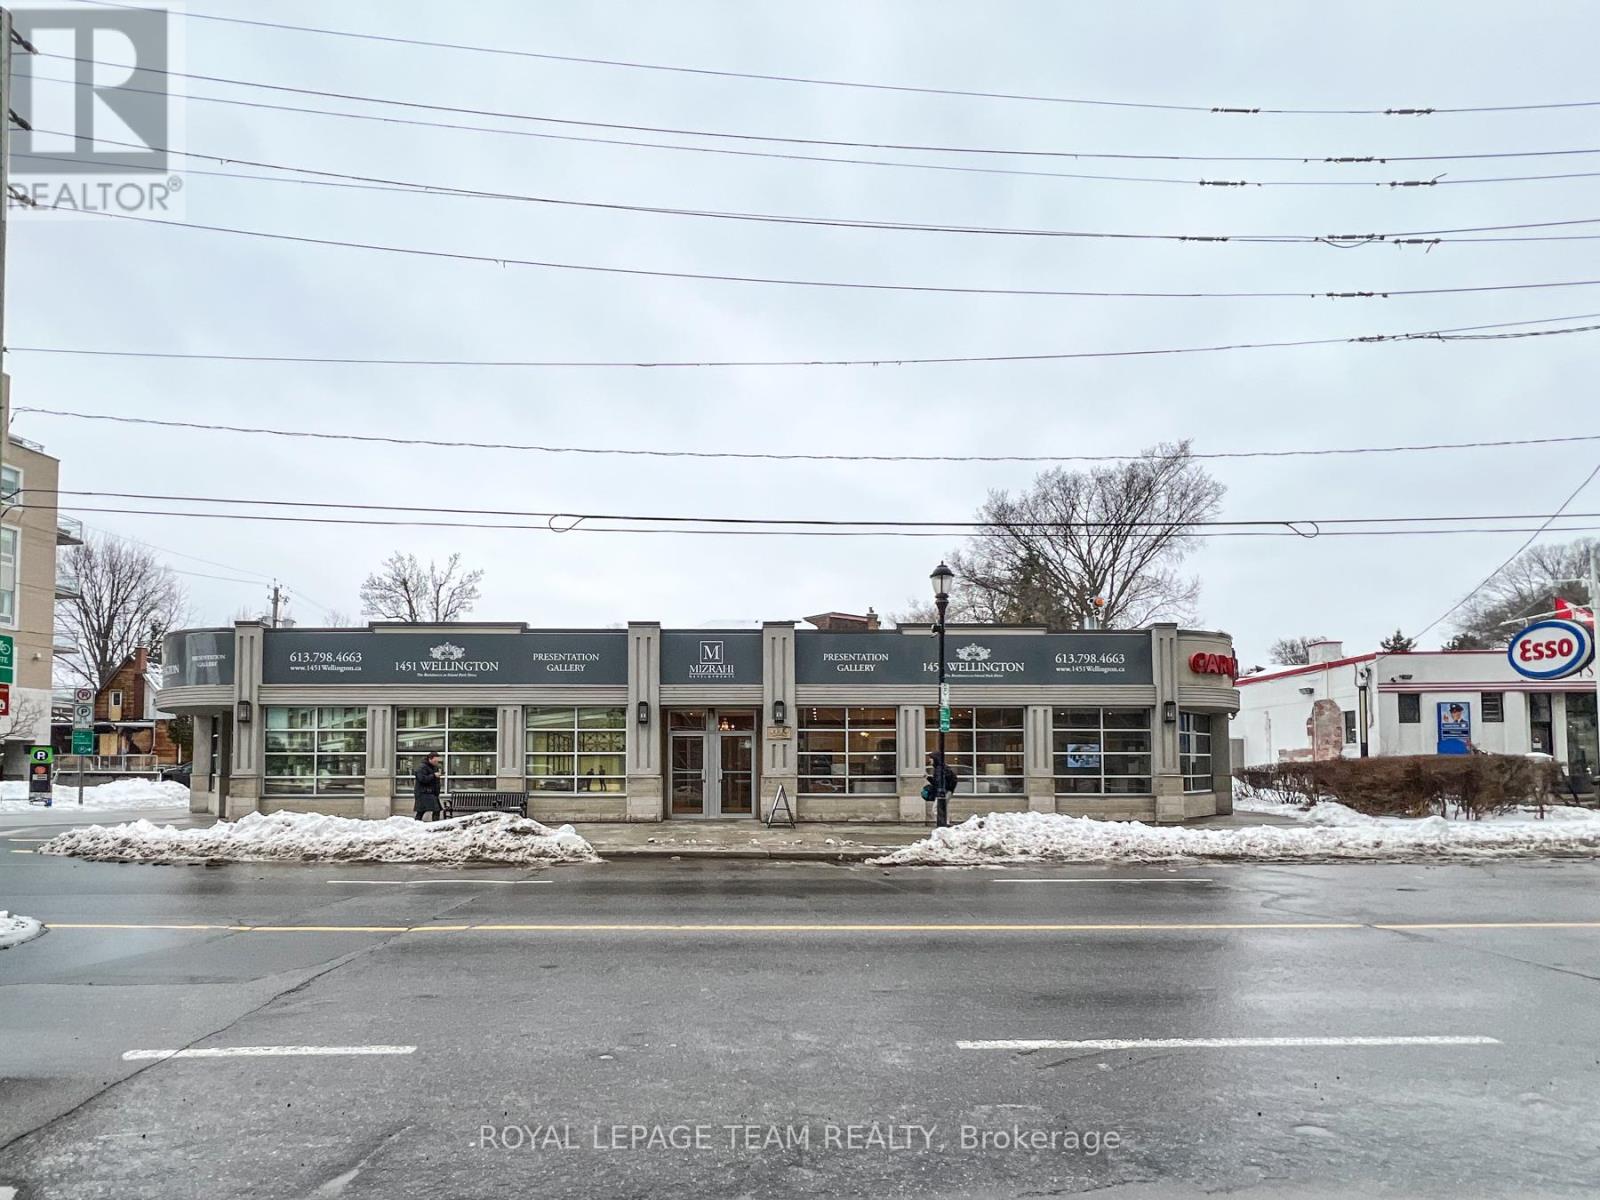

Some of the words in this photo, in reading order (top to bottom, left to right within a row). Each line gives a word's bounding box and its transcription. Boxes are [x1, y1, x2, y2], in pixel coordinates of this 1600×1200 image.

[289, 652, 362, 662] 613.798.4663
[533, 653, 599, 661] PRESENTATION
[703, 645, 720, 660] M
[823, 653, 889, 661] PRESENTATION
[1055, 653, 1125, 664] 613.798.4663
[395, 661, 416, 671] 1451
[420, 661, 499, 671] WELLINGTON
[546, 664, 586, 672] GALLERY
[689, 664, 734, 673] MIZRAHI
[837, 664, 876, 672] GALLERY
[922, 662, 940, 672] 145
[947, 662, 1025, 672] WELLINGTON
